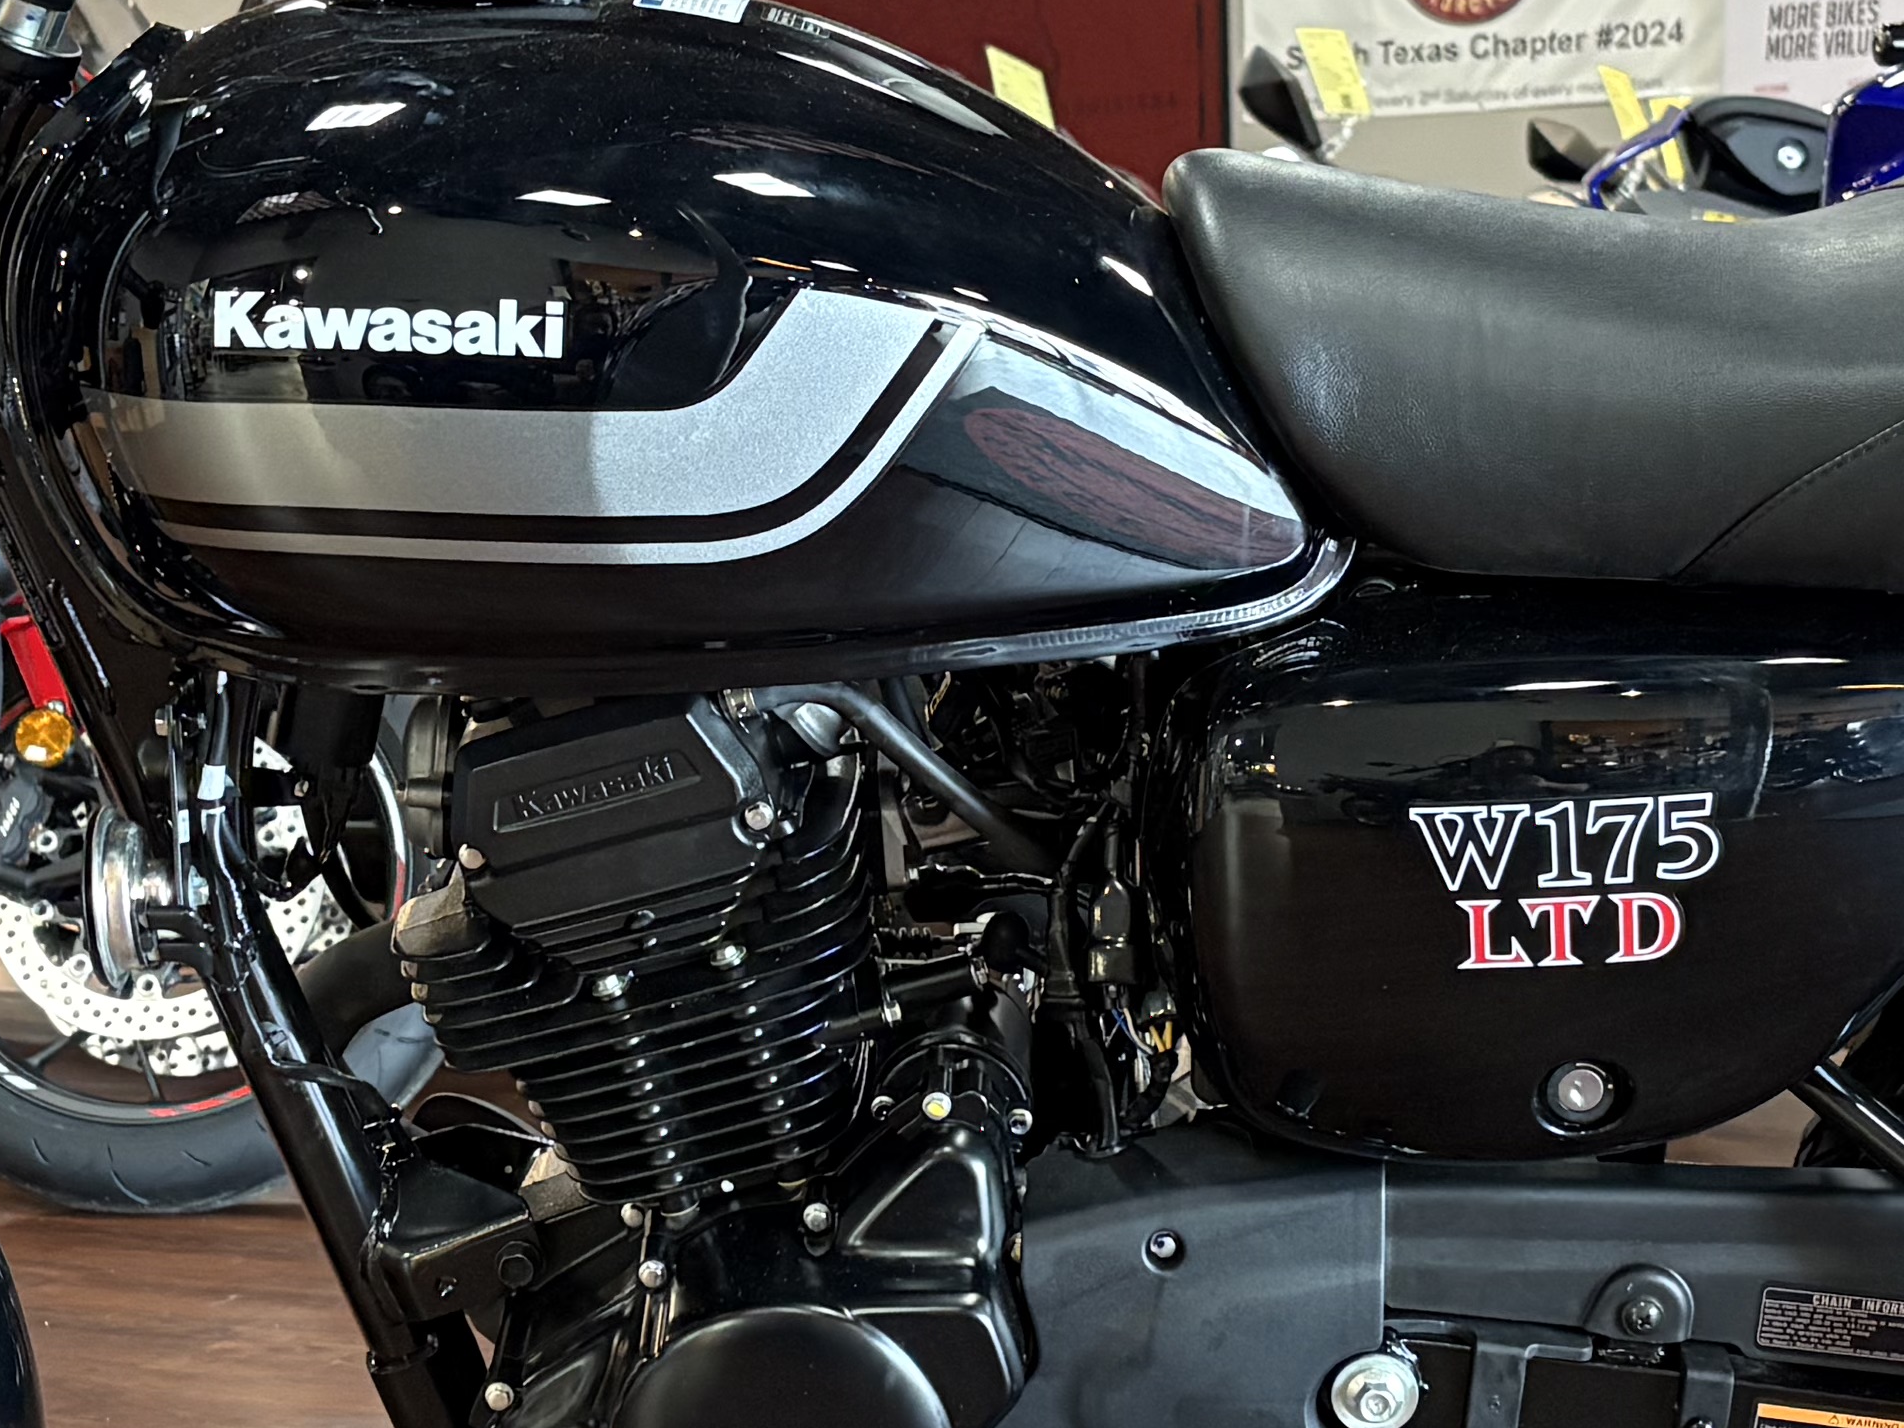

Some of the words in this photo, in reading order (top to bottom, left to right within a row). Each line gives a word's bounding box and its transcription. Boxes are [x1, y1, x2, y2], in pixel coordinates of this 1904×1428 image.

[1377, 37, 1459, 65] Texas
[1469, 30, 1584, 62] Chapter
[1596, 18, 1684, 49] #2024
[1767, 0, 1820, 31] MORE
[1765, 32, 1820, 61] MORE
[1823, 28, 1874, 59] VALU
[213, 290, 564, 359] Kawasaki
[517, 755, 676, 819] Kawasaki
[1409, 792, 1721, 891] W175
[1455, 892, 1682, 970] LTD
[1812, 1294, 1851, 1309] CHAIN
